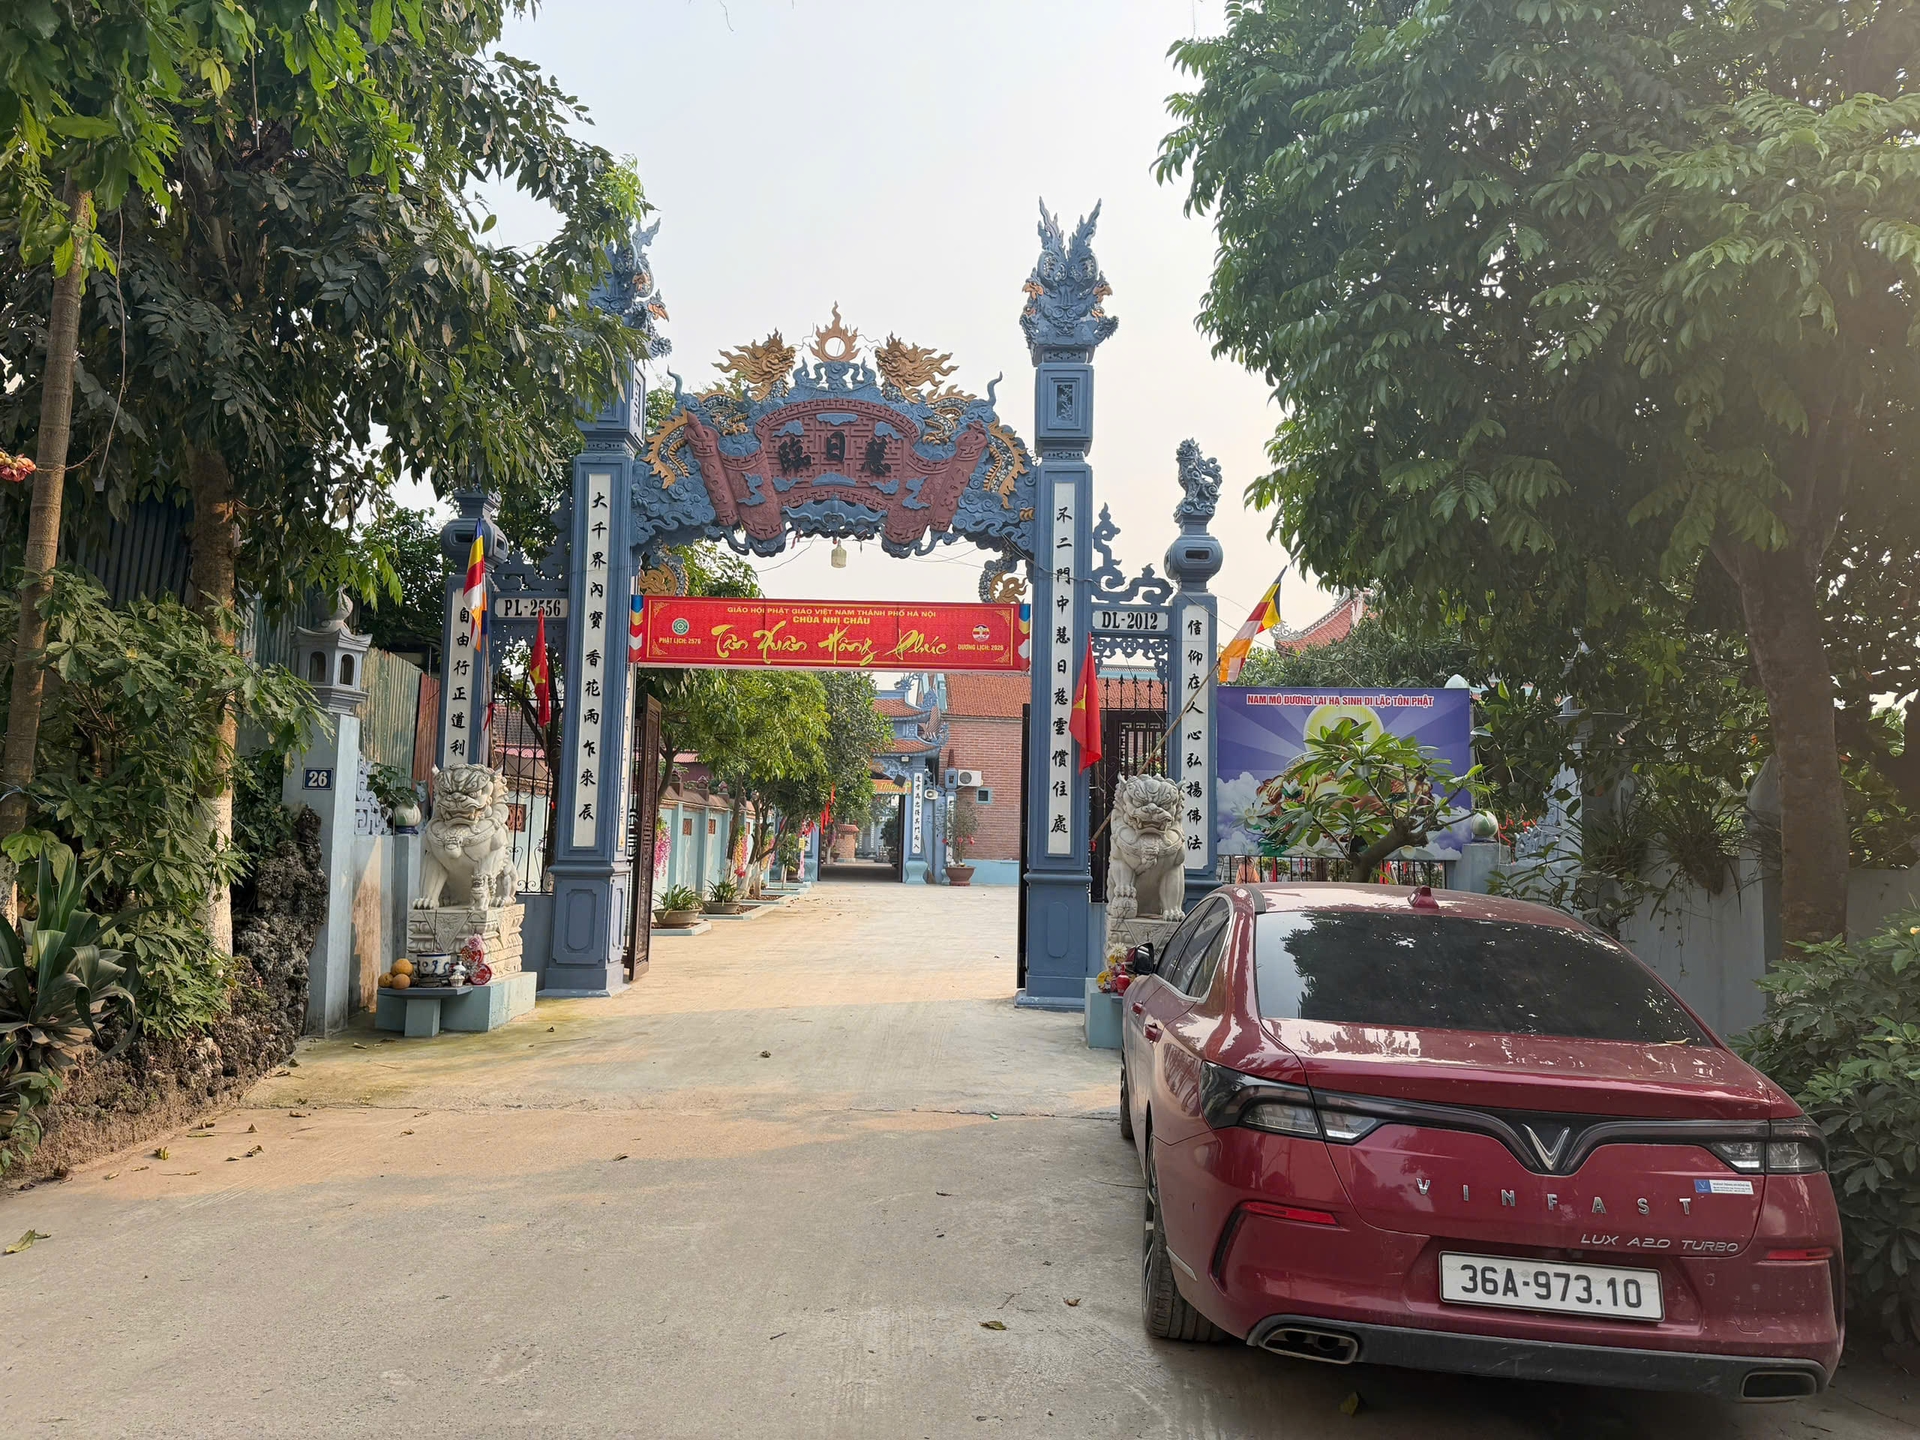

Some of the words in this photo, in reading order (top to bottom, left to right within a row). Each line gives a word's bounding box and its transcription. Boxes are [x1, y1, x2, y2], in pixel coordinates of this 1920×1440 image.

[727, 606, 748, 614] GIÁO
[751, 606, 765, 615] HỘI
[767, 607, 789, 616] PHẬT
[792, 607, 812, 615] GIÁO
[815, 607, 833, 617] VIỆT
[857, 608, 885, 617] THÀNH
[907, 609, 920, 617] HÀ
[793, 614, 819, 624] CHÙA
[843, 615, 871, 625] CHÂU
[1102, 611, 1158, 630] DL-2012
[711, 624, 749, 659] Tân
[1247, 694, 1267, 704] NAM
[1268, 693, 1282, 705] MÔ
[1314, 696, 1327, 705] LAI
[1328, 696, 1340, 707] HẠ
[1343, 696, 1362, 706] SINH
[1364, 696, 1373, 706] DI
[1392, 694, 1410, 706] TÔN
[1412, 694, 1434, 708] PHẬT
[308, 771, 328, 787] 26
[1416, 1177, 1691, 1215] VINFAST
[1581, 1234, 1619, 1245] LUX
[1681, 1240, 1739, 1252] TURBO
[1460, 1264, 1642, 1309] 36A-973.10
